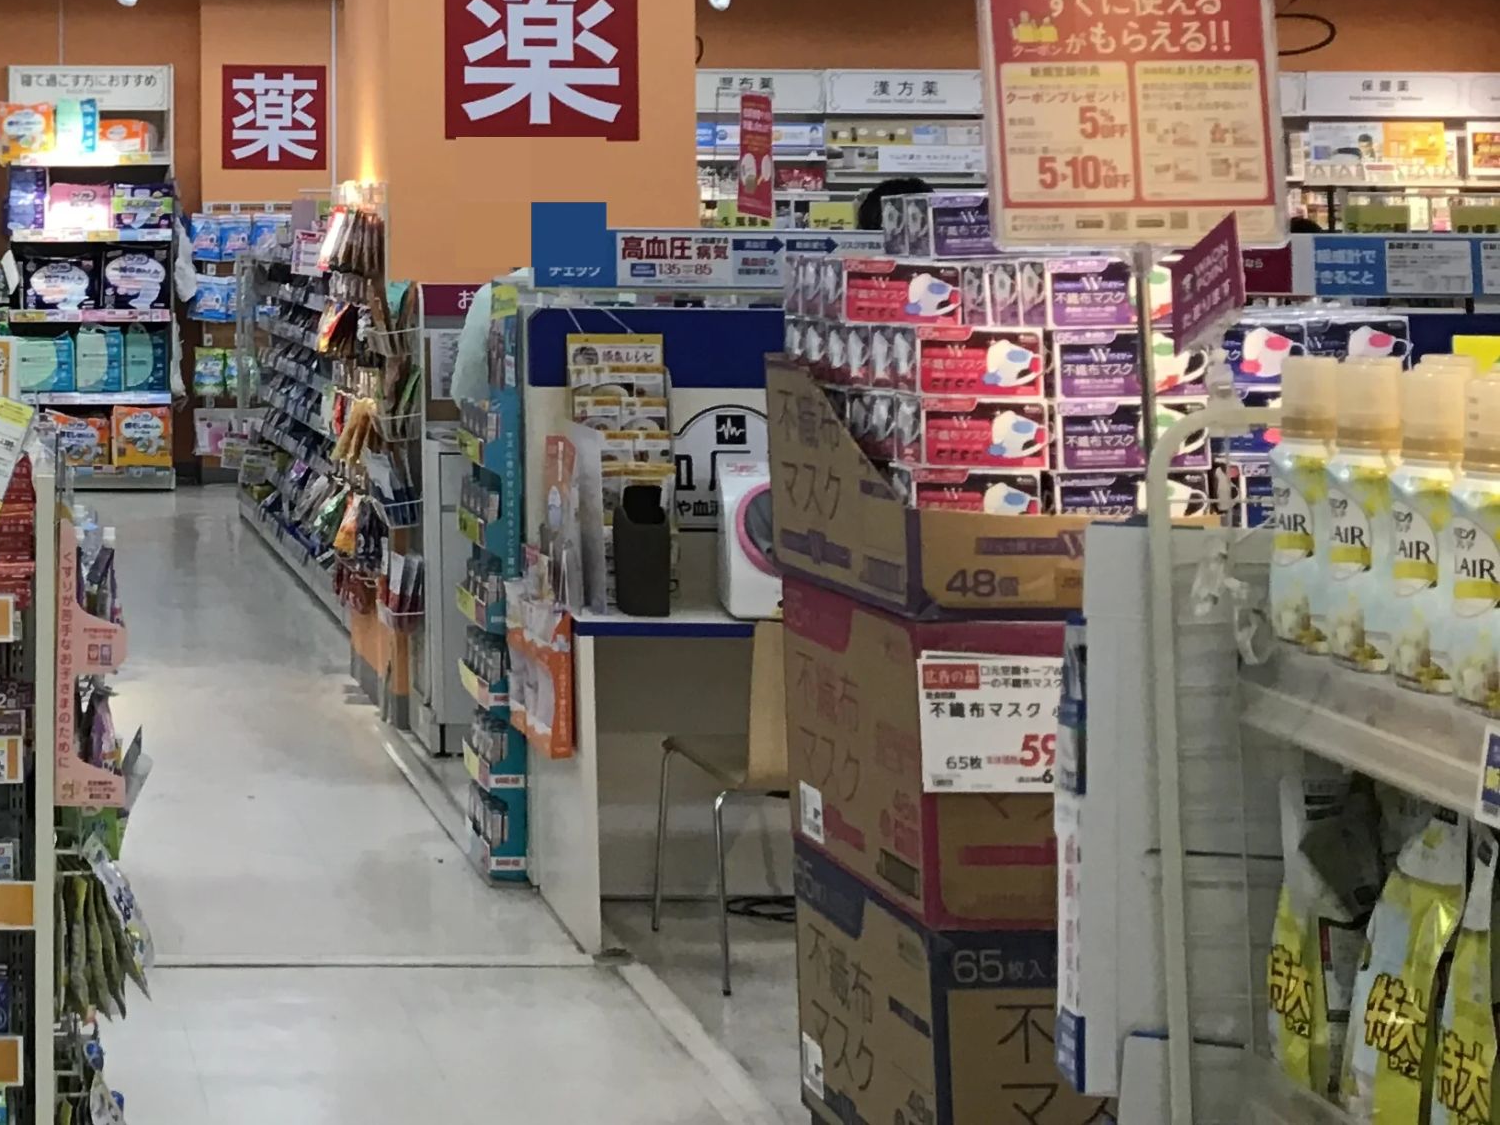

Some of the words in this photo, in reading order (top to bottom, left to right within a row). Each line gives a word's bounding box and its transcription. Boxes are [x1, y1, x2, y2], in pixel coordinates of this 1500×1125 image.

[873, 80, 940, 96] 漢方薬
[231, 72, 318, 162] 薬
[1078, 105, 1099, 139] 5
[938, 225, 990, 237] 不織布マス
[621, 236, 693, 261] 高血圧
[696, 245, 729, 261] 病気
[1317, 271, 1375, 285] きること
[1055, 290, 1127, 304] 不織布マスク
[1063, 361, 1134, 376] 不織布マスク
[1065, 433, 1136, 448] 不織布マスク
[781, 462, 841, 521] マスク
[929, 701, 1041, 718] 不織布マスク
[945, 755, 983, 770] 65枚
